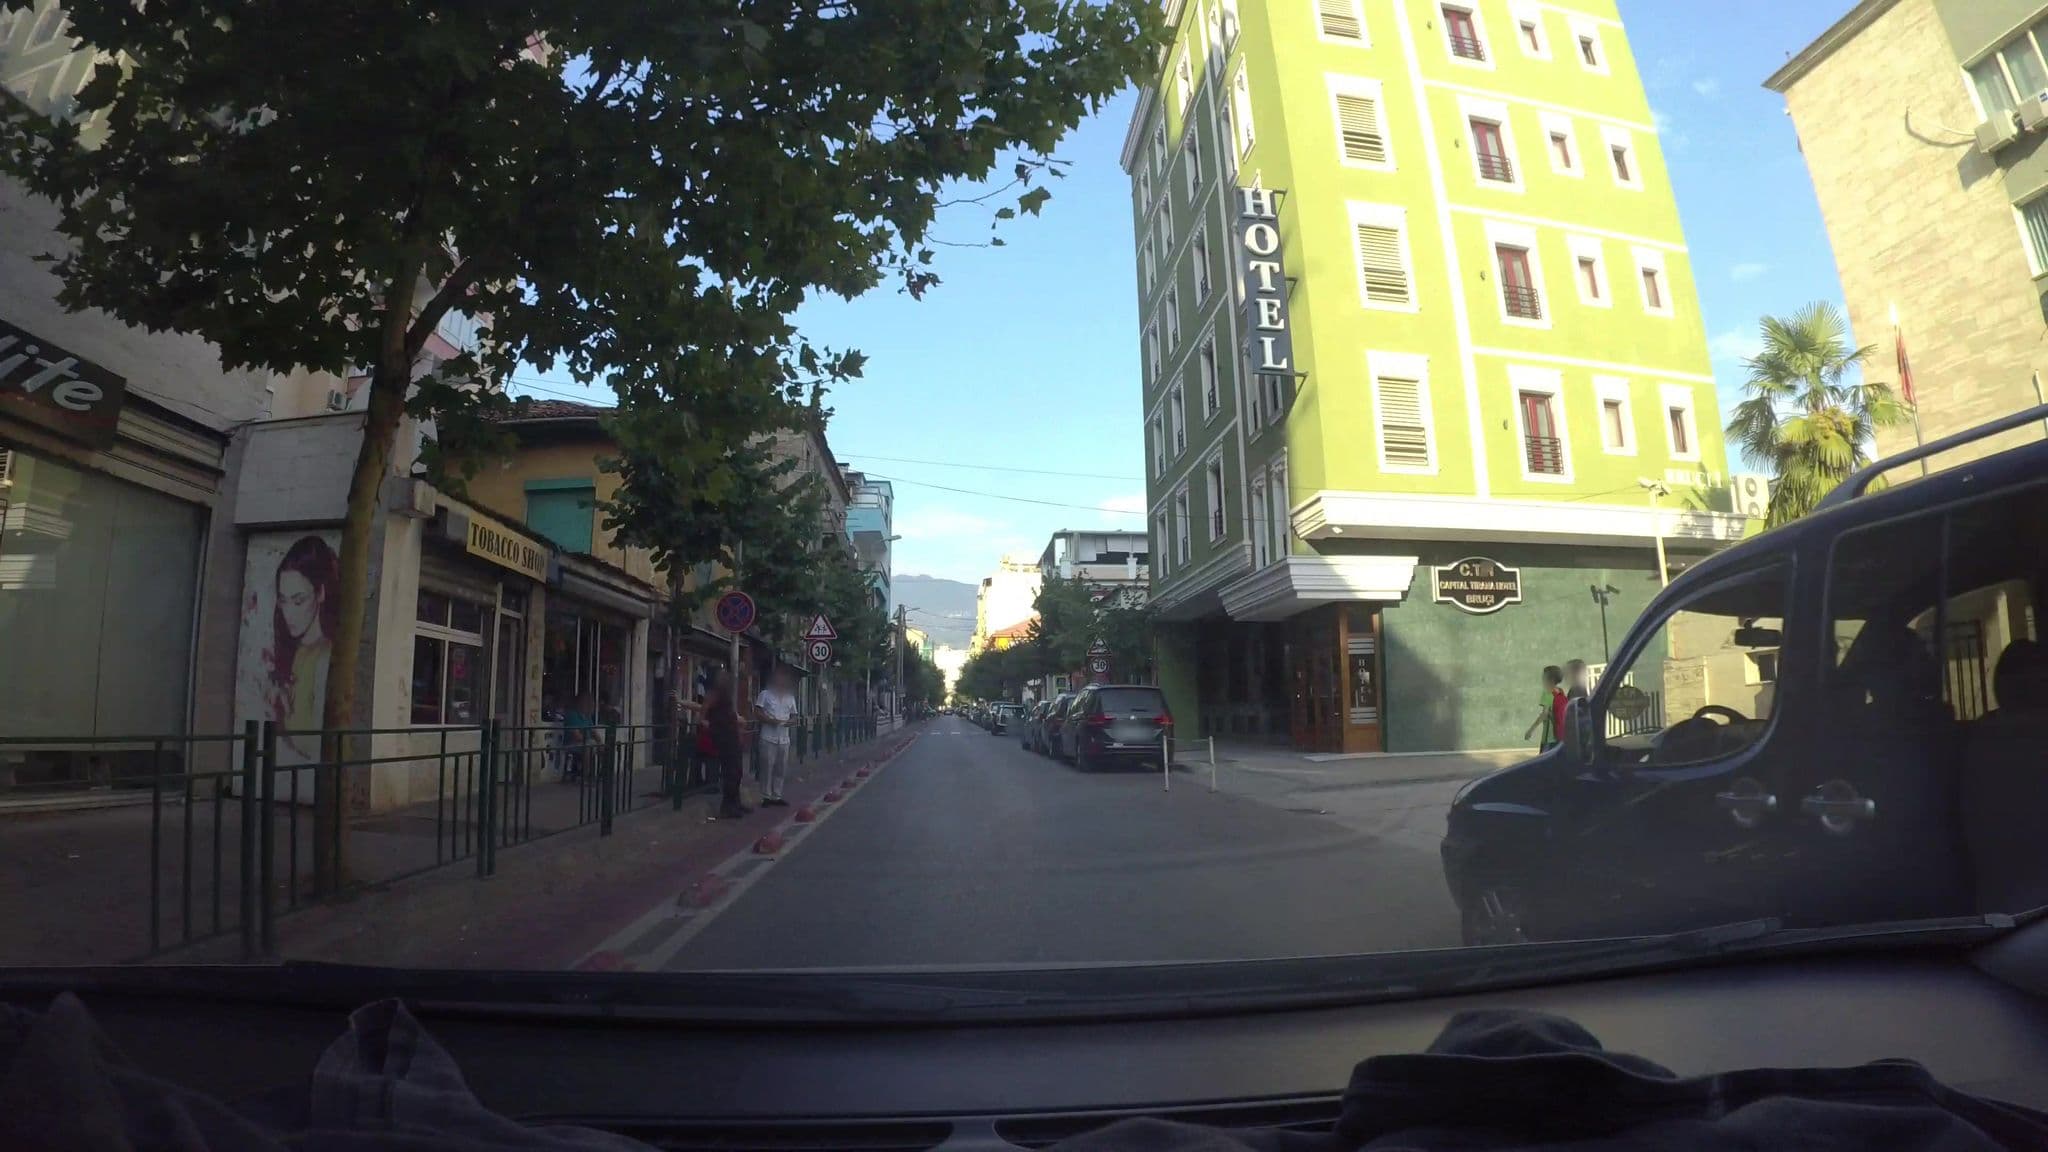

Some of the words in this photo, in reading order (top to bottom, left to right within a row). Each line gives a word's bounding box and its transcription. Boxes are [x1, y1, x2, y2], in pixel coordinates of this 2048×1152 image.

[1241, 187, 1288, 370] HOTEL
[471, 522, 520, 563] TOBACCO
[1439, 581, 1469, 590] CAPITAL
[814, 646, 827, 657] 30
